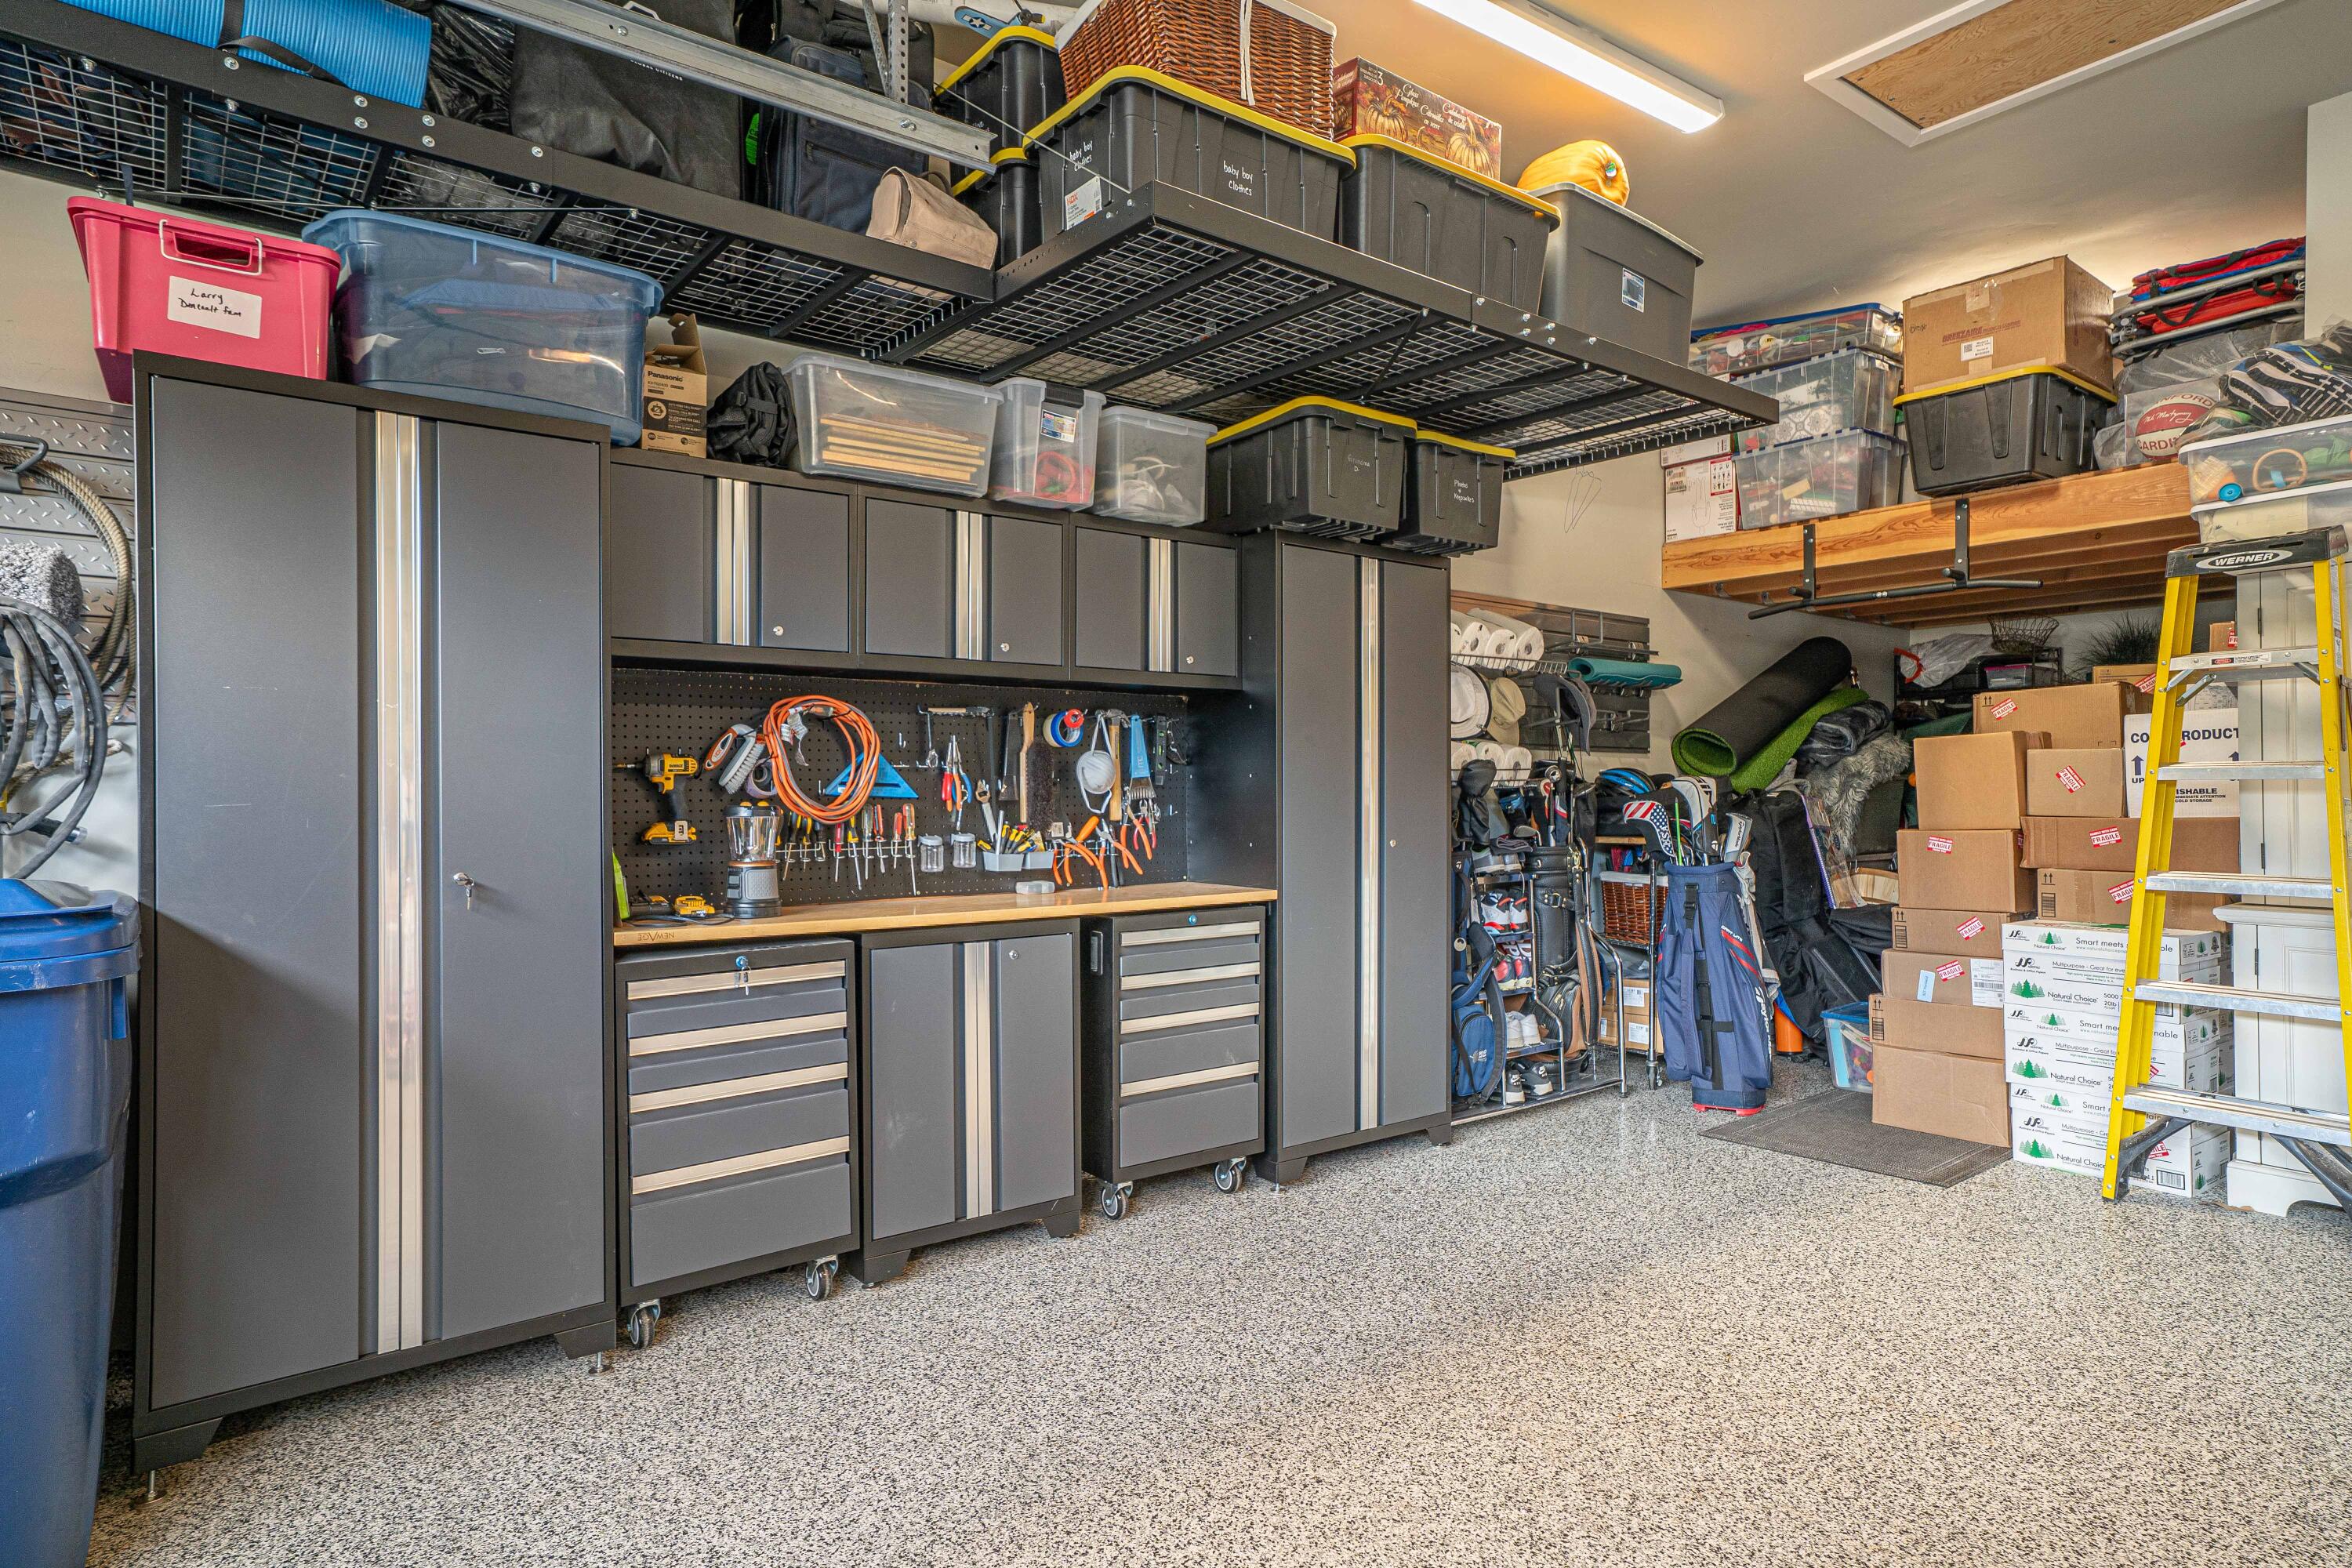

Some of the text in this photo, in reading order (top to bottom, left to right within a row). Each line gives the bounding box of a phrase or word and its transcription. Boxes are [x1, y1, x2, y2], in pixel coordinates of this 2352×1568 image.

[1377, 71, 1384, 86] 3
[1403, 83, 1419, 99] Glass
[1396, 88, 1420, 109] Pumpkins
[1083, 140, 1093, 152] boy
[1223, 160, 1254, 184] baby boy
[1067, 192, 1079, 205] HDX
[191, 288, 223, 305] Larry
[1942, 326, 1983, 343] BREEZAIRE
[648, 371, 683, 382] Panasonic
[2215, 553, 2274, 566] WERNER
[1994, 702, 2015, 717] FRAGILE
[2060, 769, 2079, 790] FRAGILE
[1661, 826, 1671, 848] USA
[2092, 833, 2120, 843] FRAGILE
[1929, 841, 1951, 850] FRAGILE
[1961, 921, 1982, 937] FRAGILE
[637, 931, 674, 942] NEWAGE
[2076, 937, 2099, 946] Smart
[1940, 966, 1962, 978] FRAGILE
[2080, 1020, 2103, 1029] Smart
[2056, 1042, 2089, 1052] Multipurpose
[2050, 1073, 2101, 1085] Natural Choice
[2082, 1101, 2106, 1112] Smart
[2062, 1123, 2095, 1134] Multipurpose
[2056, 1153, 2082, 1163] Natural
